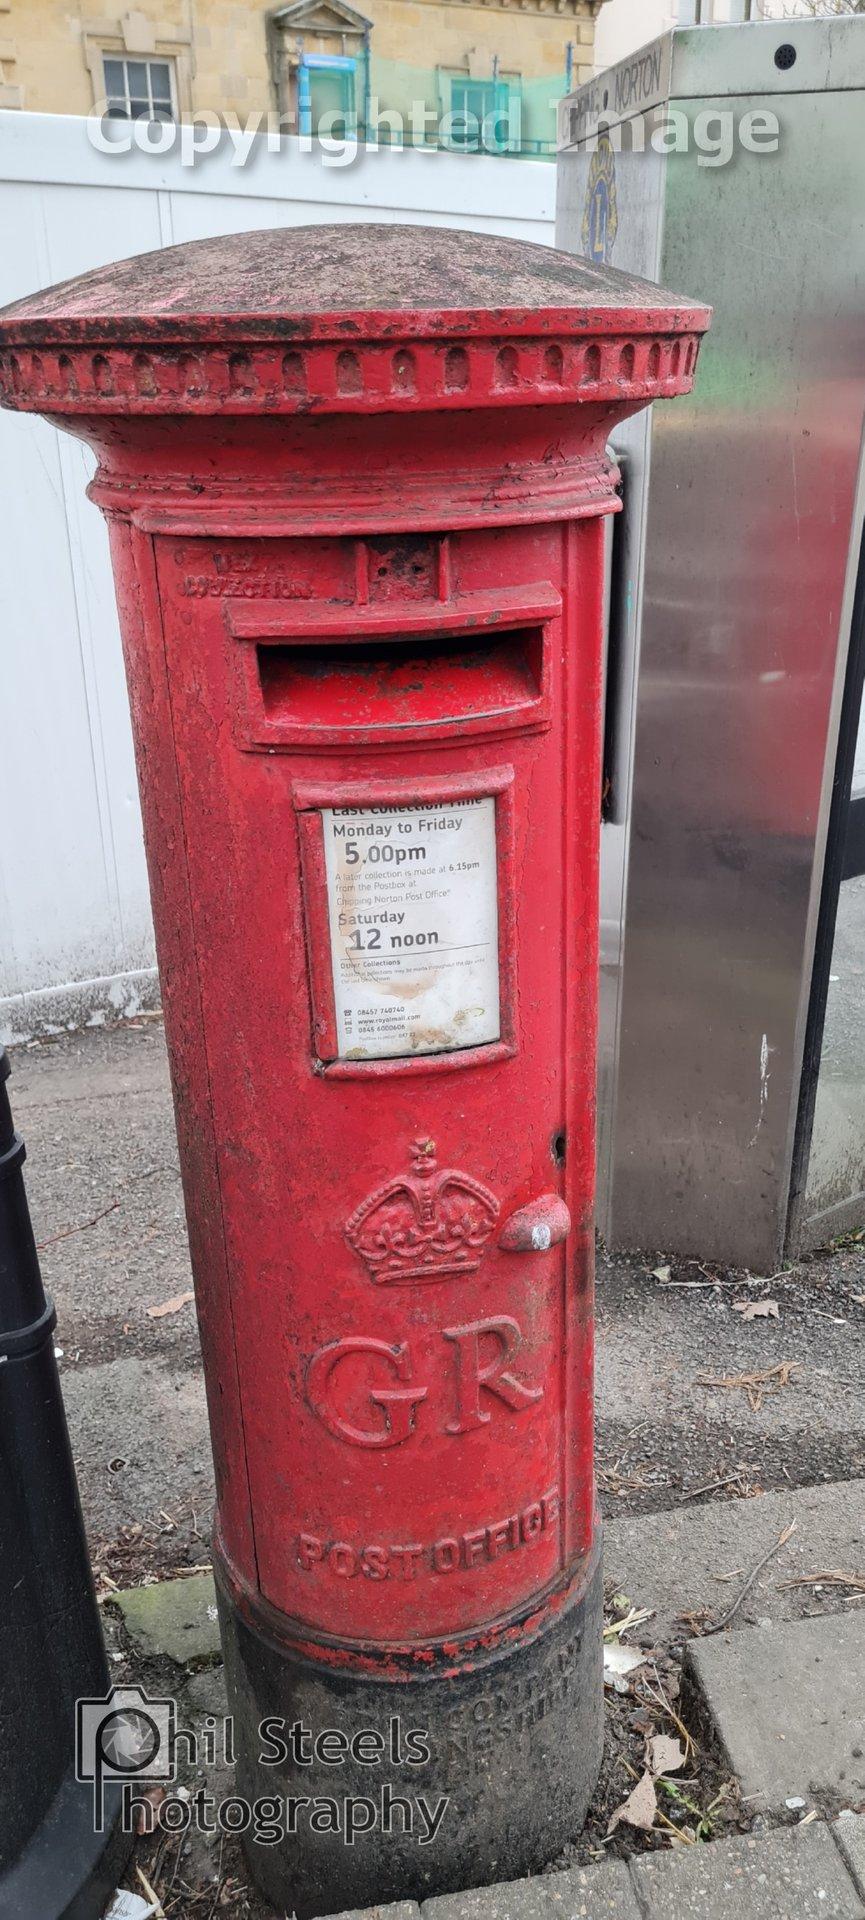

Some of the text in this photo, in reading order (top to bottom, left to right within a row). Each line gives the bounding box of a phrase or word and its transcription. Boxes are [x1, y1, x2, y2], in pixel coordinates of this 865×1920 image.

[615, 49, 663, 111] NORTON
[333, 818, 463, 838] Monday to Friday
[345, 842, 426, 865] 5.00pm
[335, 873, 341, 881] A
[364, 870, 402, 880] collection
[413, 867, 436, 876] made
[449, 861, 480, 872] 6.15pm
[359, 882, 372, 891] the
[408, 879, 417, 888] at
[374, 894, 403, 904] Norton
[406, 892, 423, 901] Post
[338, 910, 405, 926] Saturday
[349, 928, 439, 951] 12 noon
[363, 959, 401, 968] Collections
[357, 1005, 405, 1016] 08457 740740
[358, 1013, 421, 1024] www.royalmail.com
[295, 1484, 560, 1582] POST OFFICE
